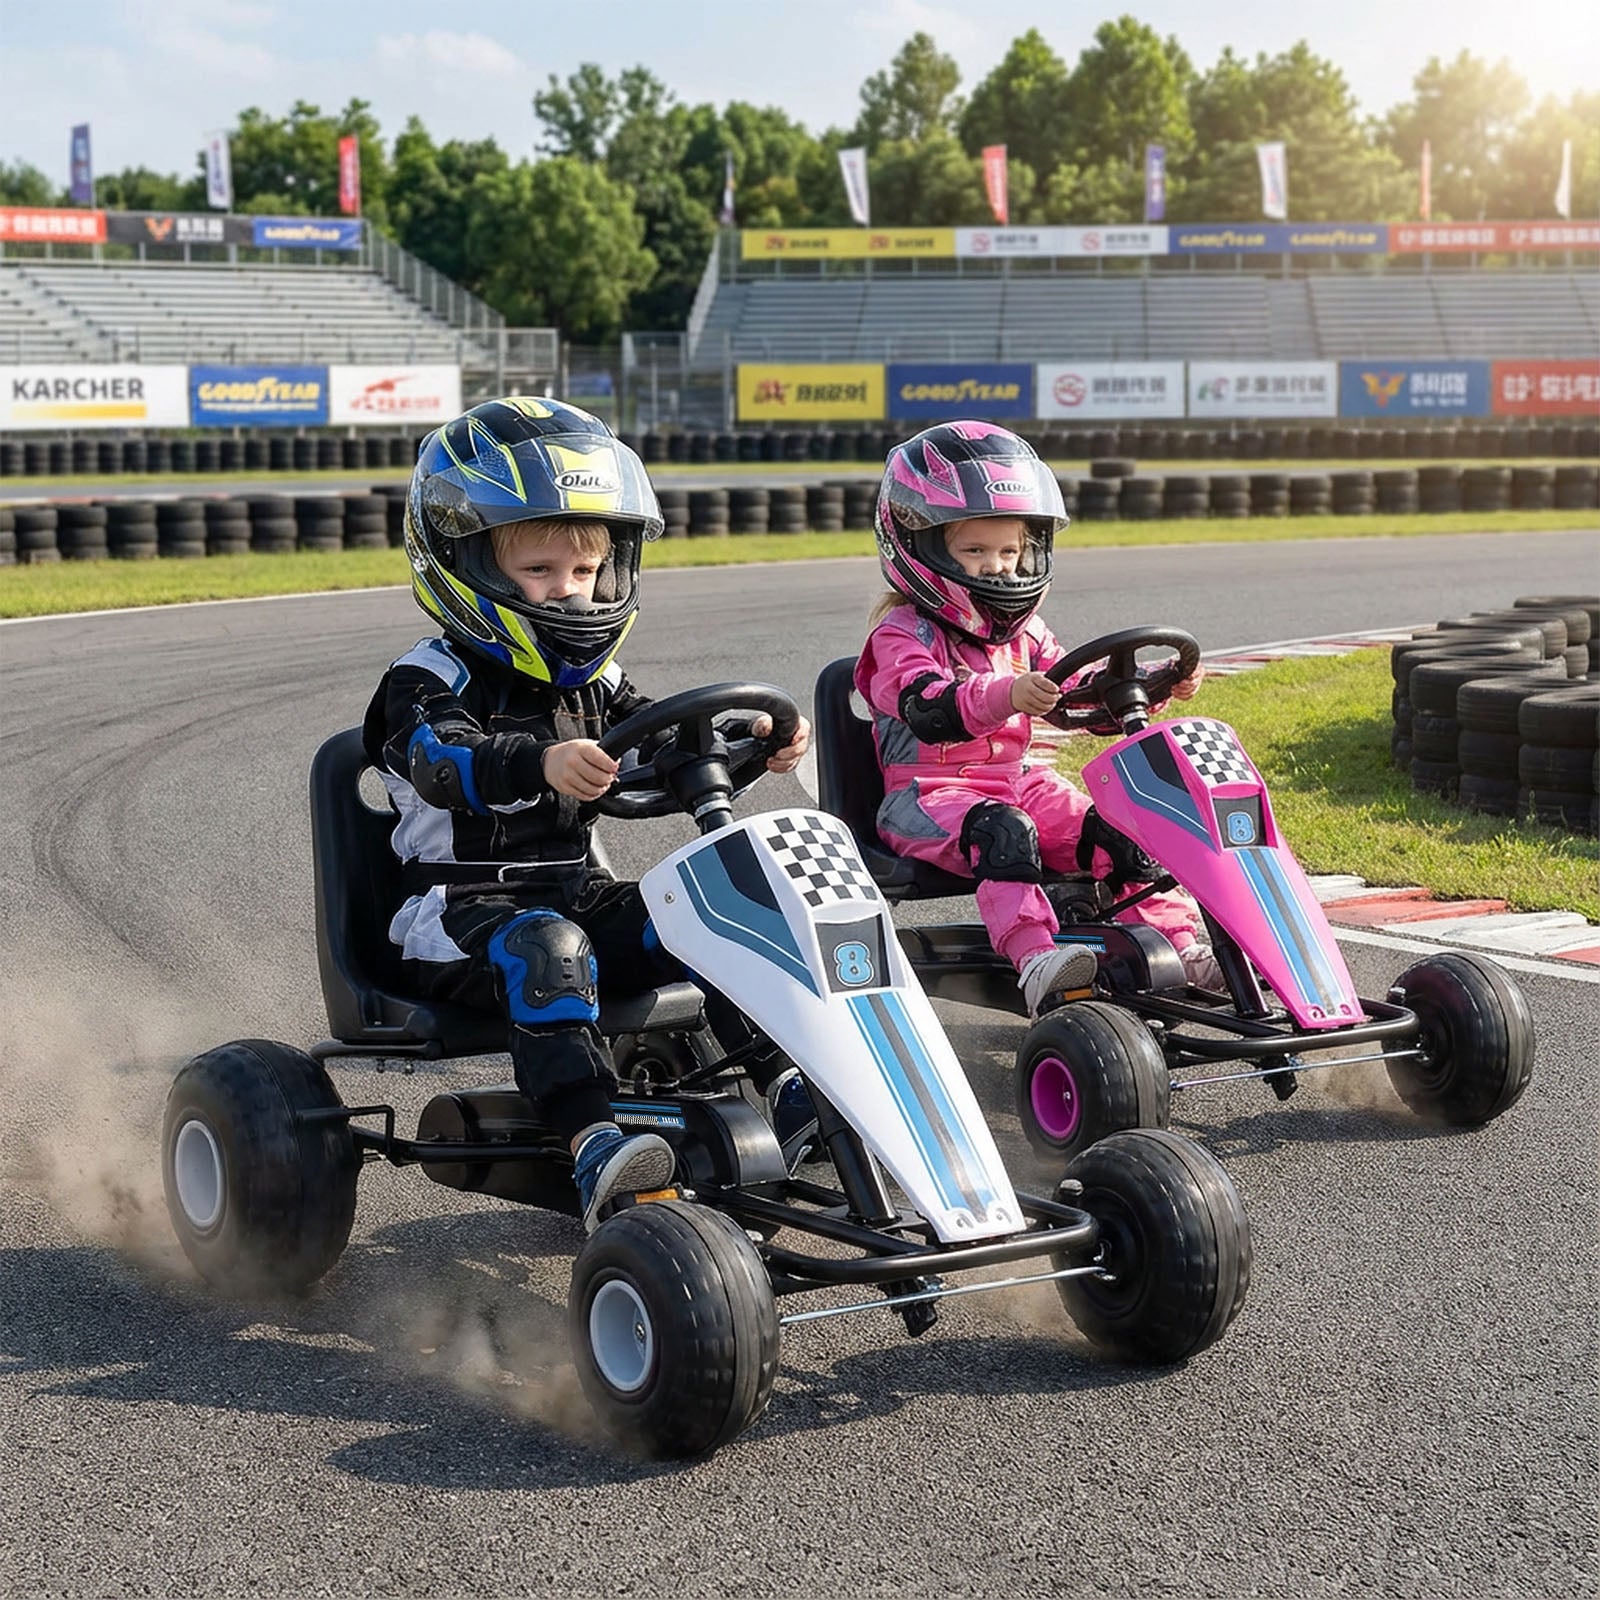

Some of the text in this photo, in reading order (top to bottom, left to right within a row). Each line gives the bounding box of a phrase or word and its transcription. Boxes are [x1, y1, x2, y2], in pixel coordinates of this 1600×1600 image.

[12, 377, 145, 400] KARCHER
[198, 376, 320, 403] GOODYEAR
[900, 379, 1020, 403] GOODYEAR
[1226, 811, 1256, 845] 8
[833, 940, 875, 988] 8
